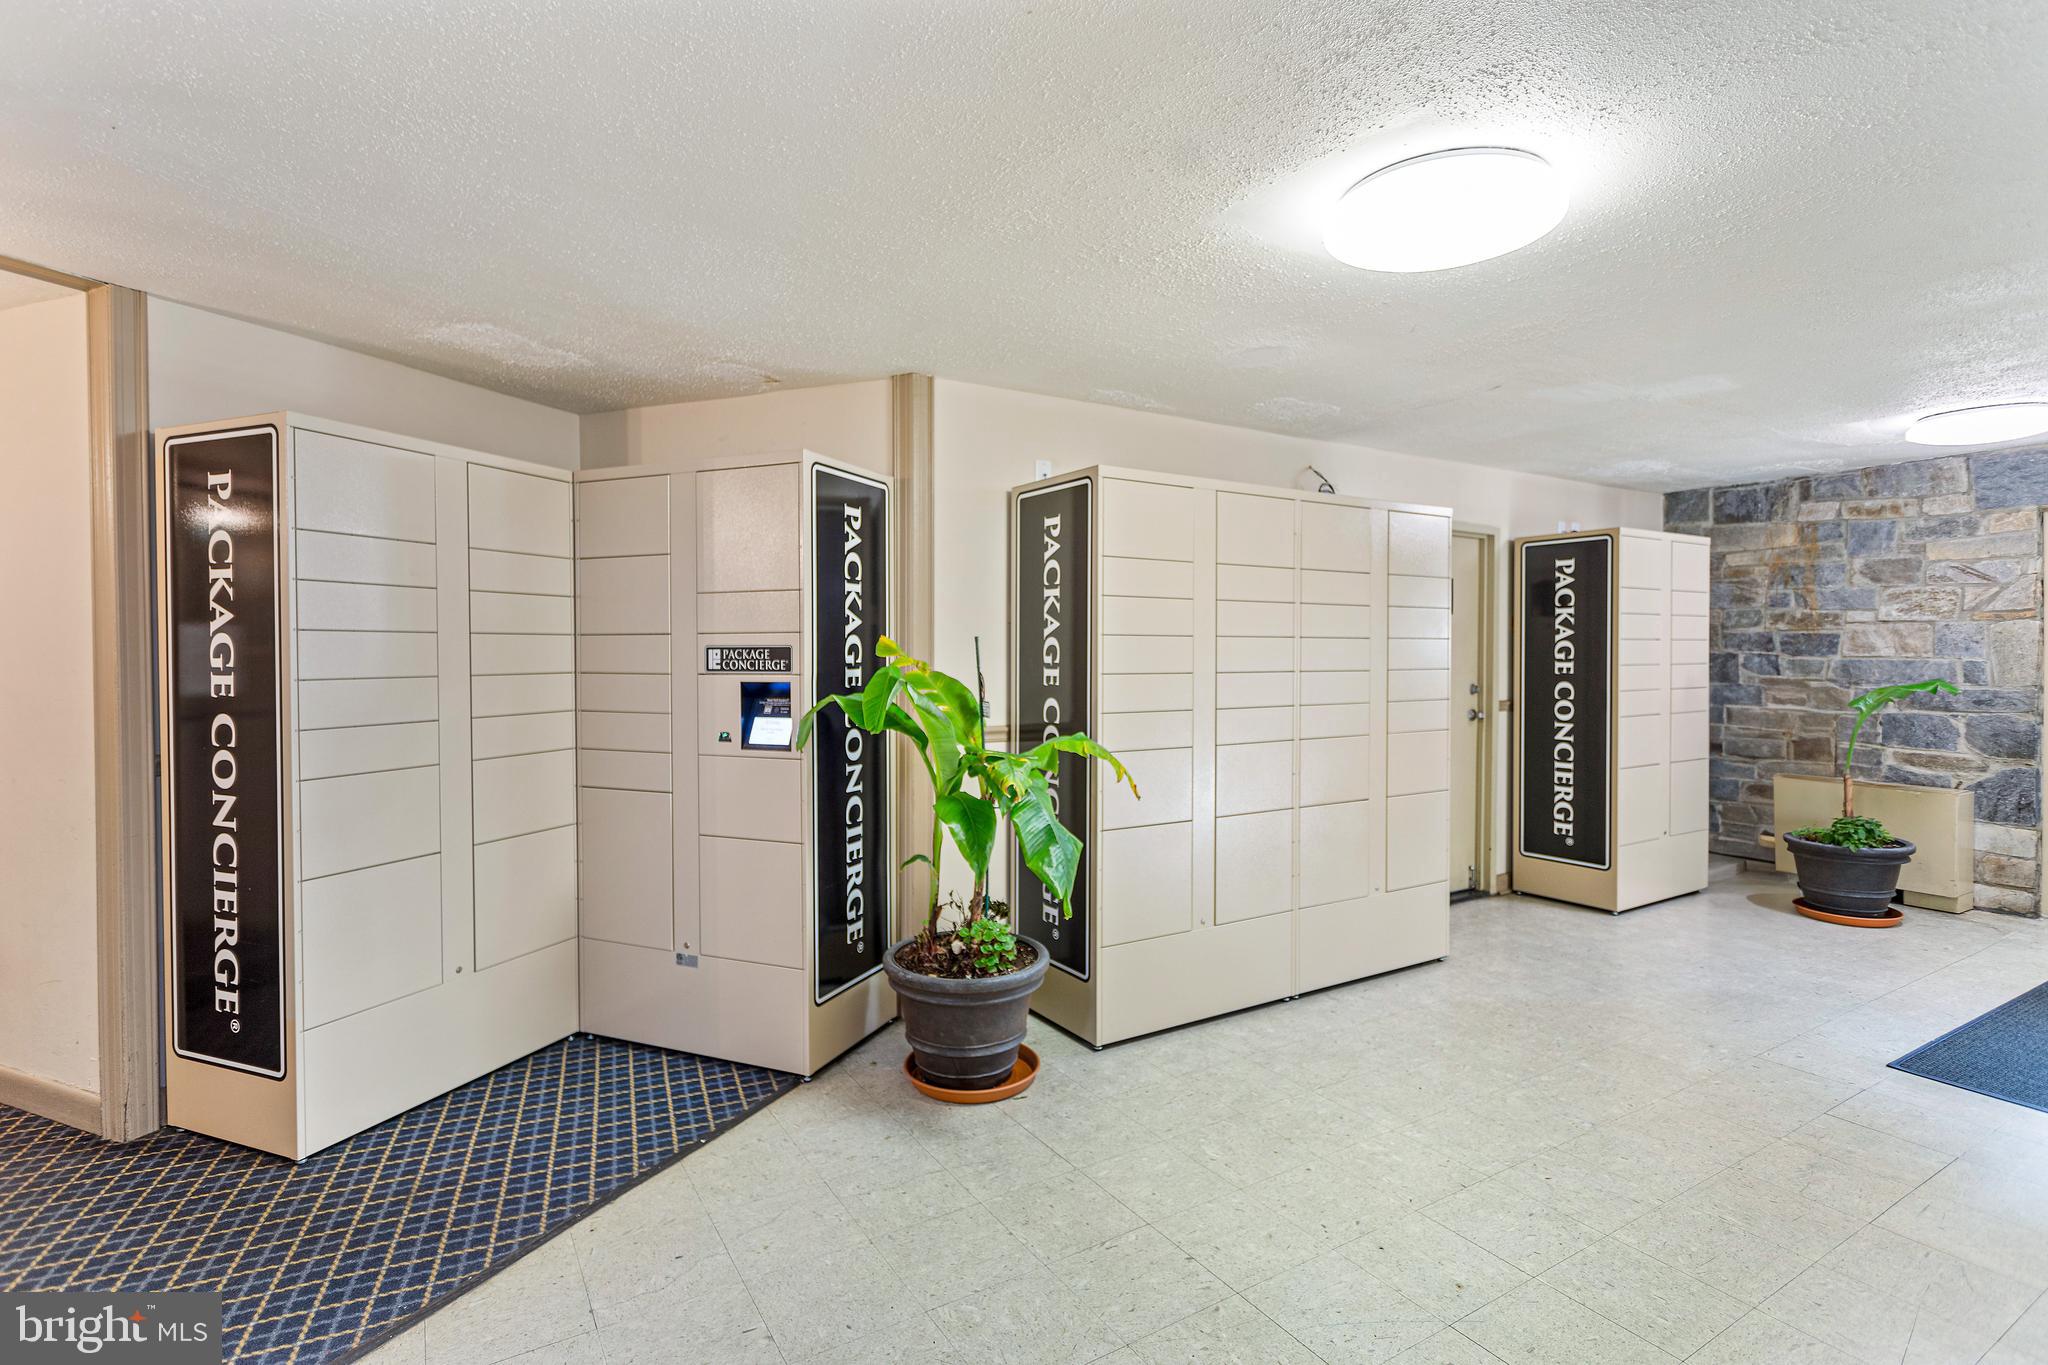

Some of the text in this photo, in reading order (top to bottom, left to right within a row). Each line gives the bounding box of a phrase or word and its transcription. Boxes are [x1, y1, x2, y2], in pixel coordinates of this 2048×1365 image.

[207, 468, 235, 698] PACKAGE
[722, 649, 770, 660] PACKAGE
[843, 502, 863, 690] PACKAGE
[1042, 513, 1061, 688] PACKAGE
[1554, 557, 1576, 676] PACKAGE
